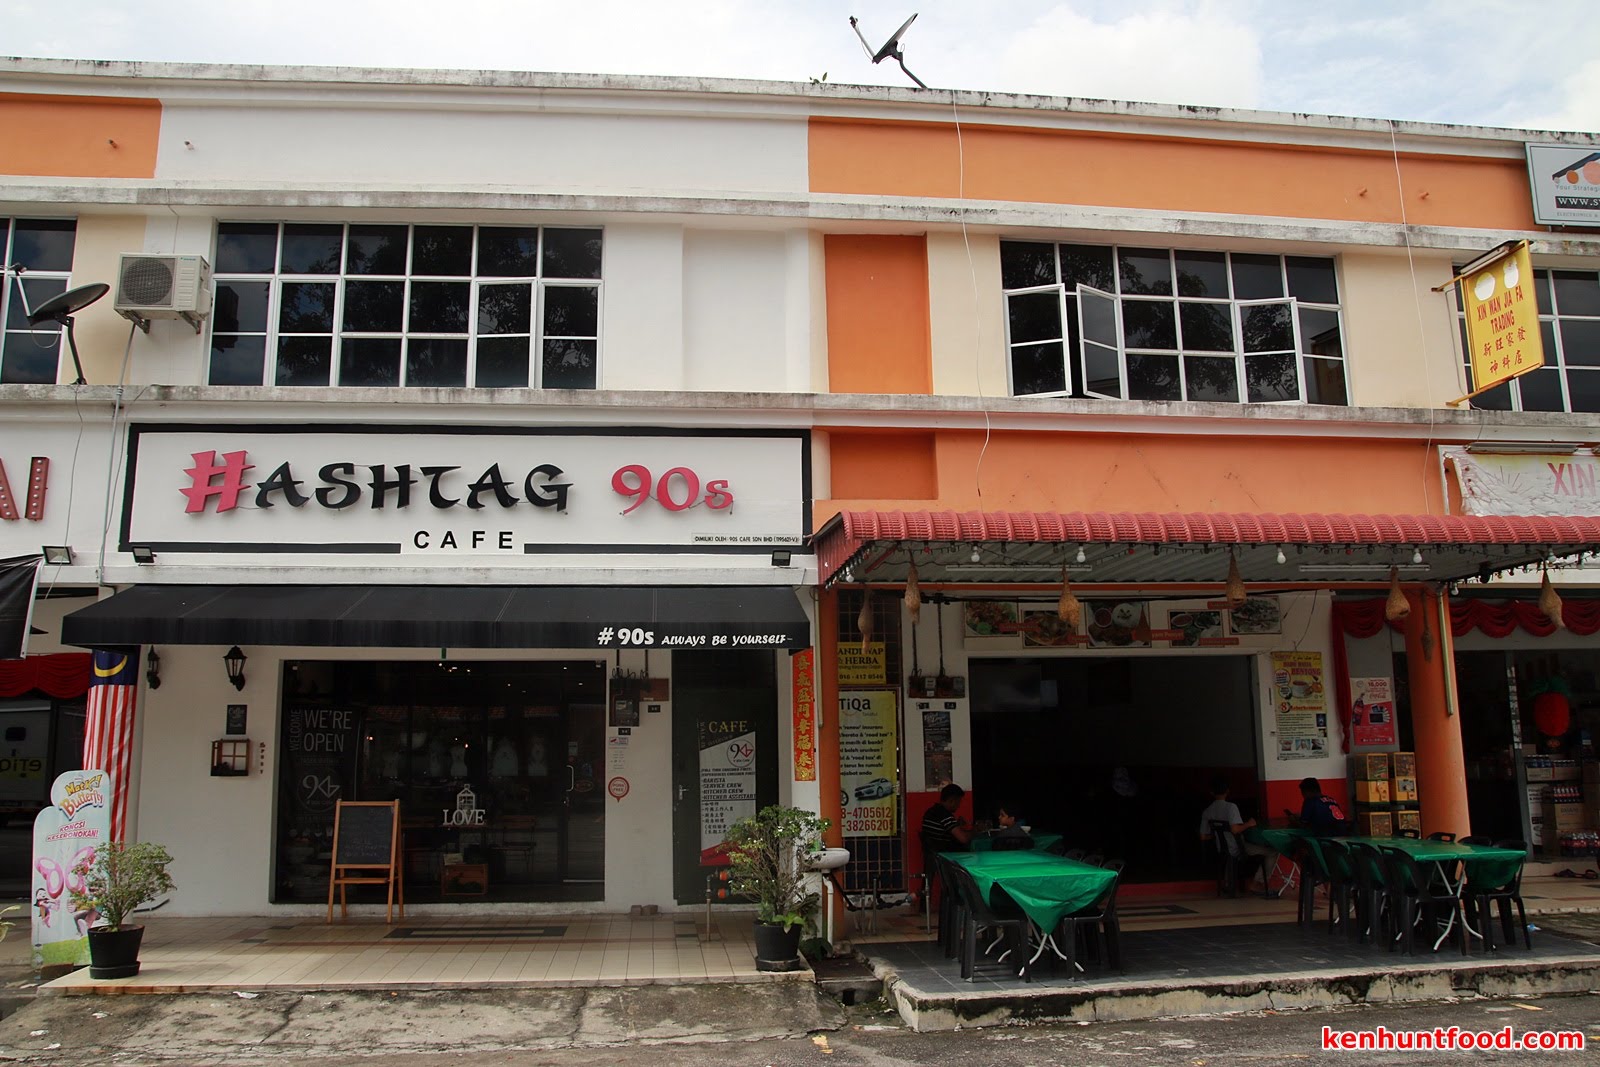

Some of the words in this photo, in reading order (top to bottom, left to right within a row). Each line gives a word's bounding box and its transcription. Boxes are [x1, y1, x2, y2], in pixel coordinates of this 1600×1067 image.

[1557, 198, 1600, 206] www.s
[1477, 304, 1487, 321] XIN
[1488, 296, 1501, 316] WAN
[1504, 290, 1513, 308] JIA
[1516, 285, 1524, 302] FA
[1490, 310, 1514, 334] TRADING
[179, 450, 574, 514] HASHTAG
[612, 464, 734, 516] 90s
[1547, 462, 1596, 497] XIN
[414, 531, 514, 556] CAFE
[661, 635, 706, 647] ALWAYS
[712, 635, 728, 646] BE
[839, 698, 871, 712] TiQa
[304, 710, 352, 730] WE'RE
[708, 720, 748, 733] CAFE
[289, 708, 302, 752] WELCOME
[303, 732, 344, 752] OPEN
[443, 809, 486, 826] LOVE
[841, 807, 891, 819] 8-4705612
[60, 821, 86, 832] KONGSI
[841, 820, 894, 831] -38266205
